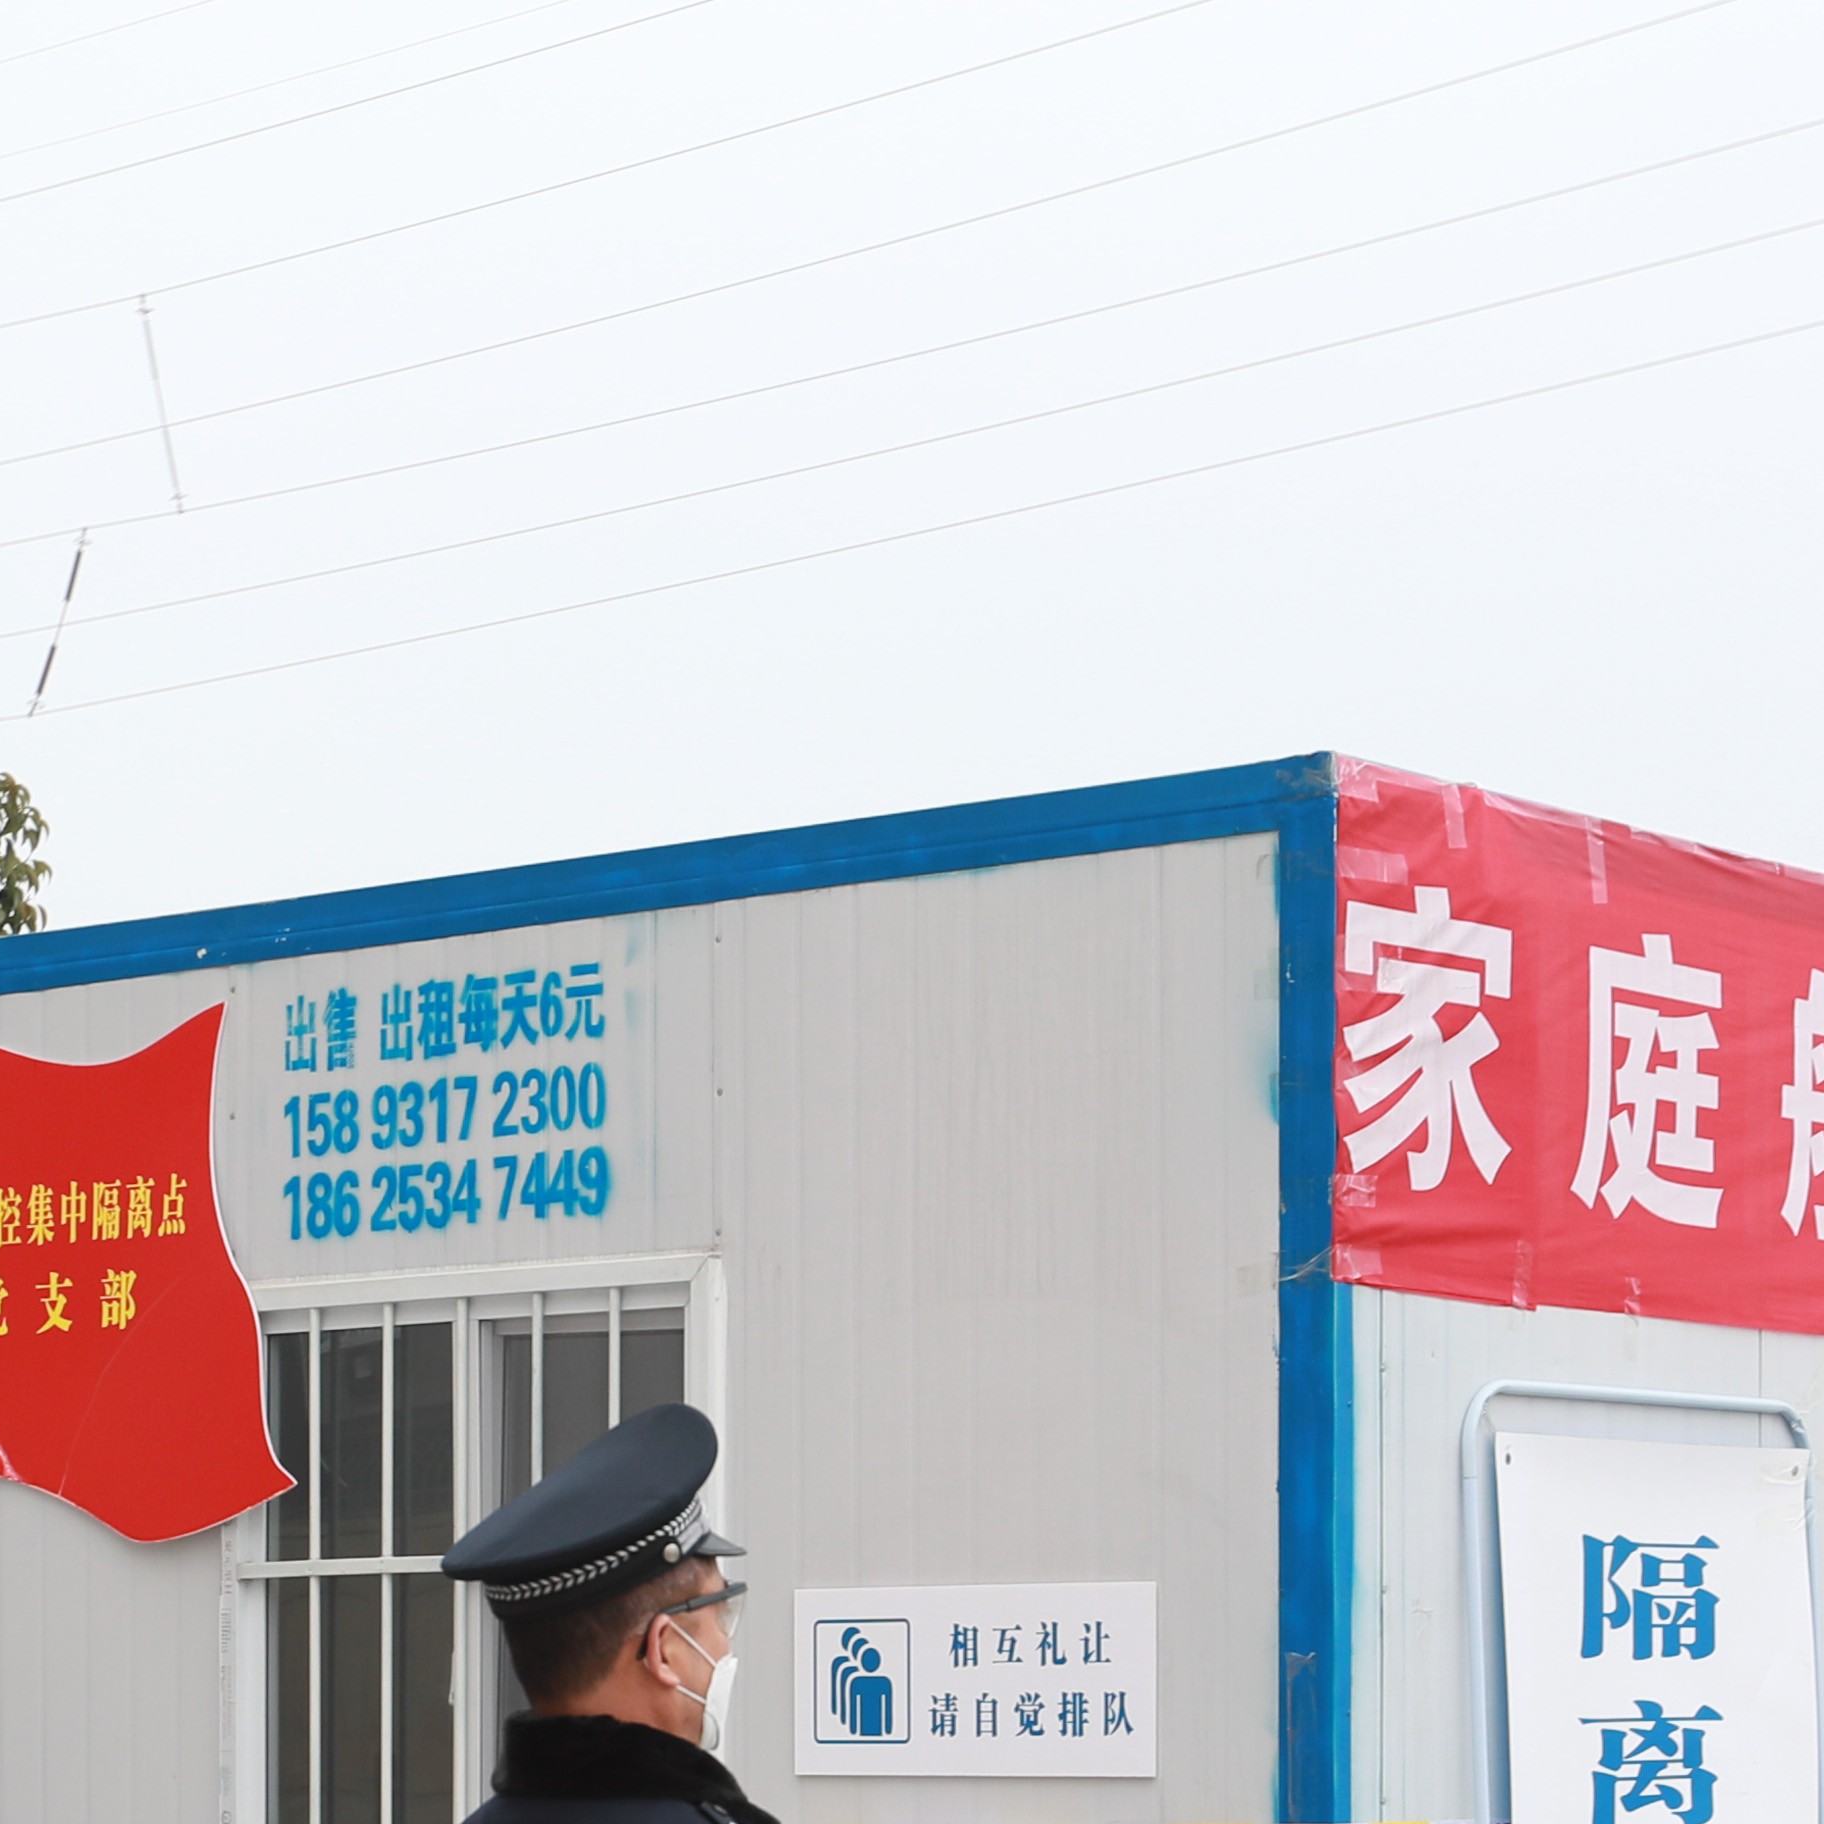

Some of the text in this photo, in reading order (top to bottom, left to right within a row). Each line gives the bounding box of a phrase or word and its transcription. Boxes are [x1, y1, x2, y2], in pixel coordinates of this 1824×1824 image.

[284, 962, 606, 1072] 出售 出租每天6元
[283, 1061, 607, 1158] 158 9317 2300
[283, 1145, 610, 1240] 186 2534 7449
[949, 1621, 1112, 1669] 相互礼让
[927, 1690, 1135, 1739] 请自觉排队
